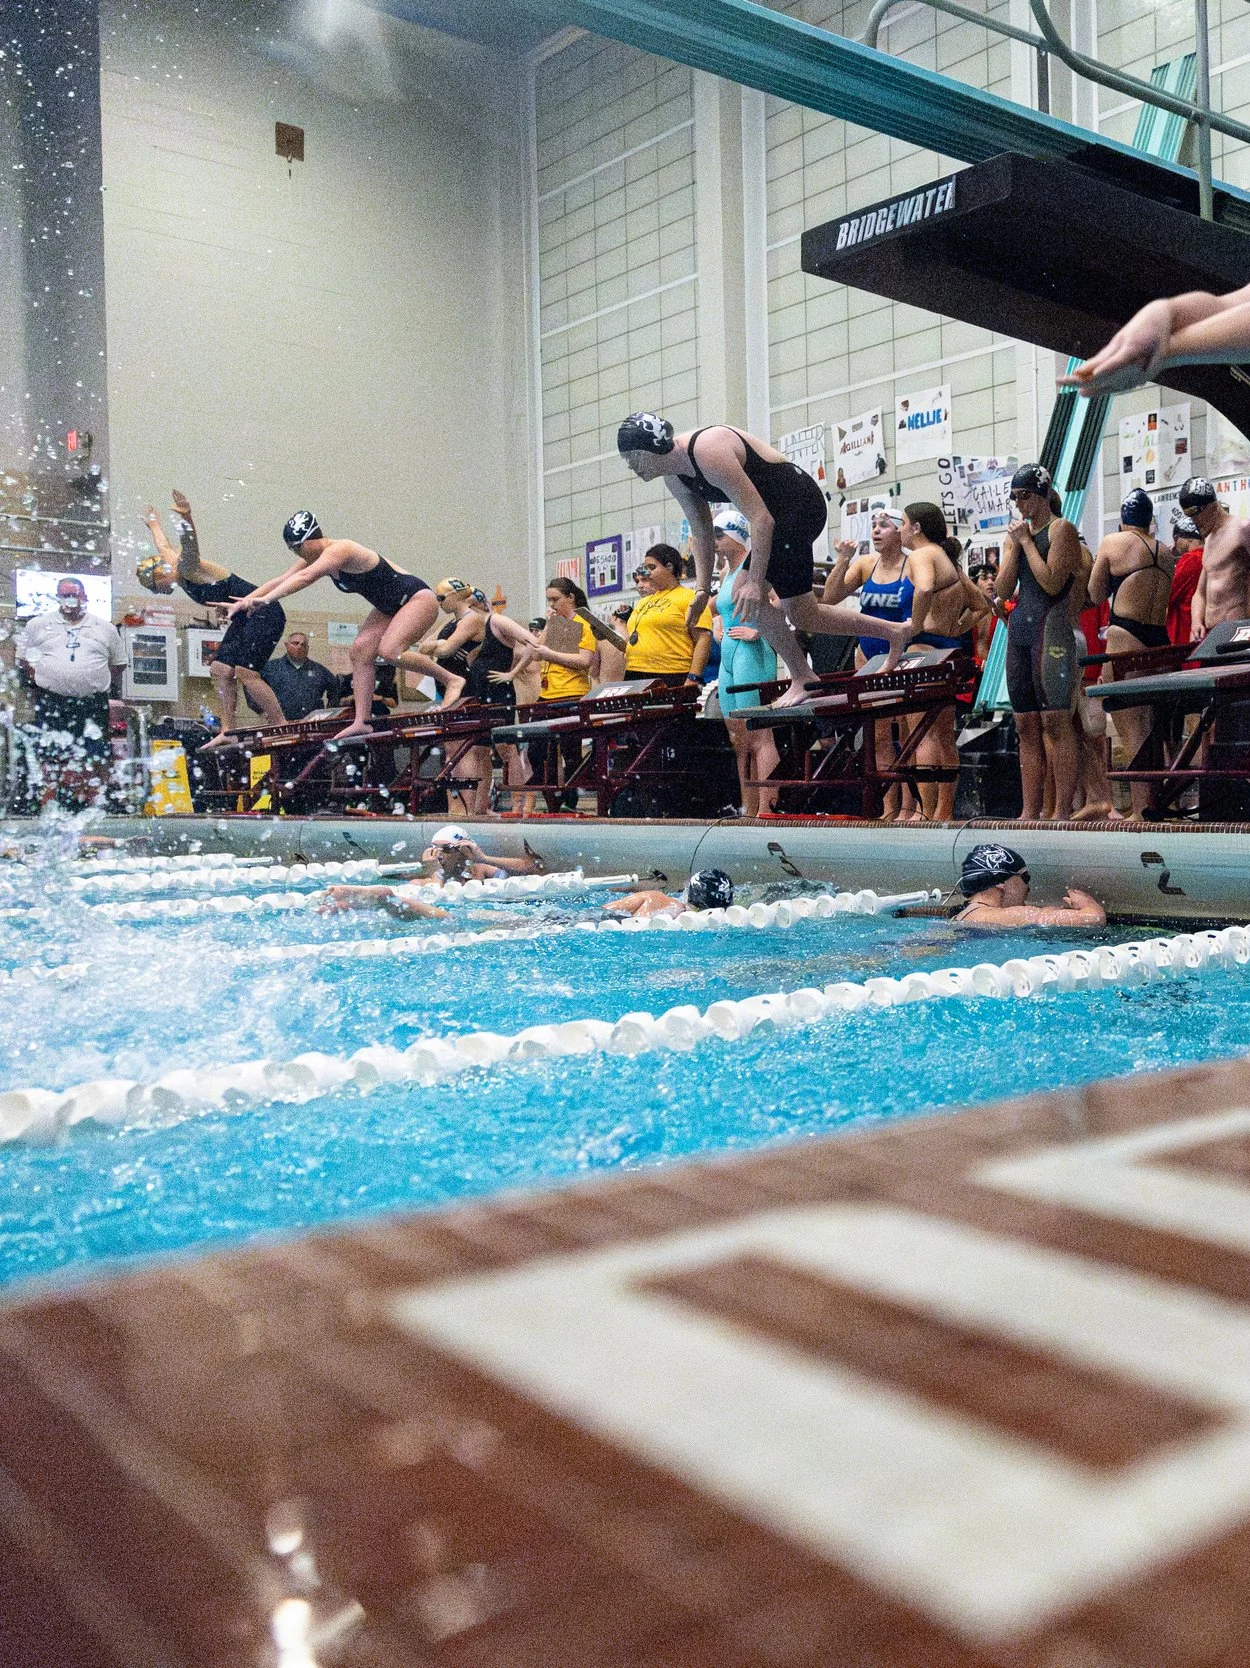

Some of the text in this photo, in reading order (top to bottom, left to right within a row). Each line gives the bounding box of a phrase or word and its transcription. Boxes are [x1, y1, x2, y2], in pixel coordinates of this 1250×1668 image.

[836, 180, 956, 250] BRIDGEWATER
[938, 458, 953, 485] GO
[1140, 851, 1187, 896] 2
